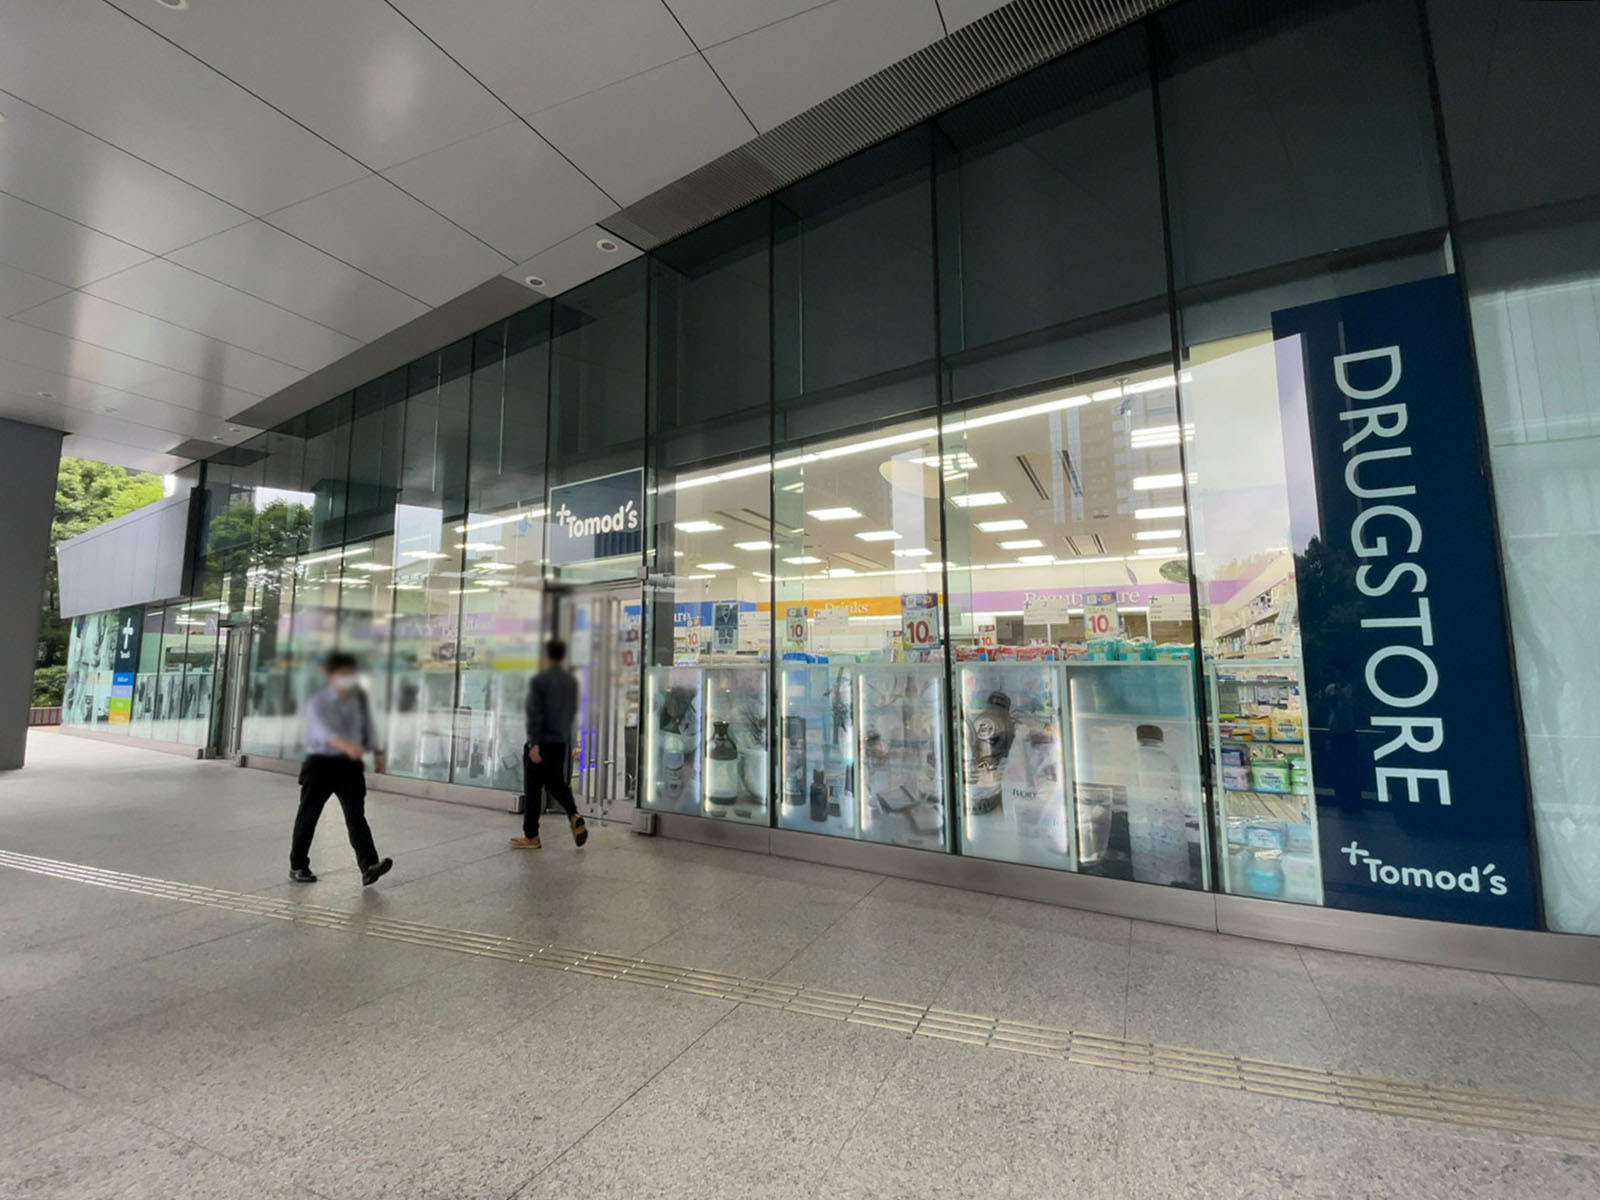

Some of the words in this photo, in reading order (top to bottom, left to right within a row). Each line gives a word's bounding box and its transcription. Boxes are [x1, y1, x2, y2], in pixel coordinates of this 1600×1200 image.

[566, 500, 638, 539] Tomod's
[1333, 345, 1452, 806] DRUGSTORE
[1362, 863, 1508, 896] Tomod's
